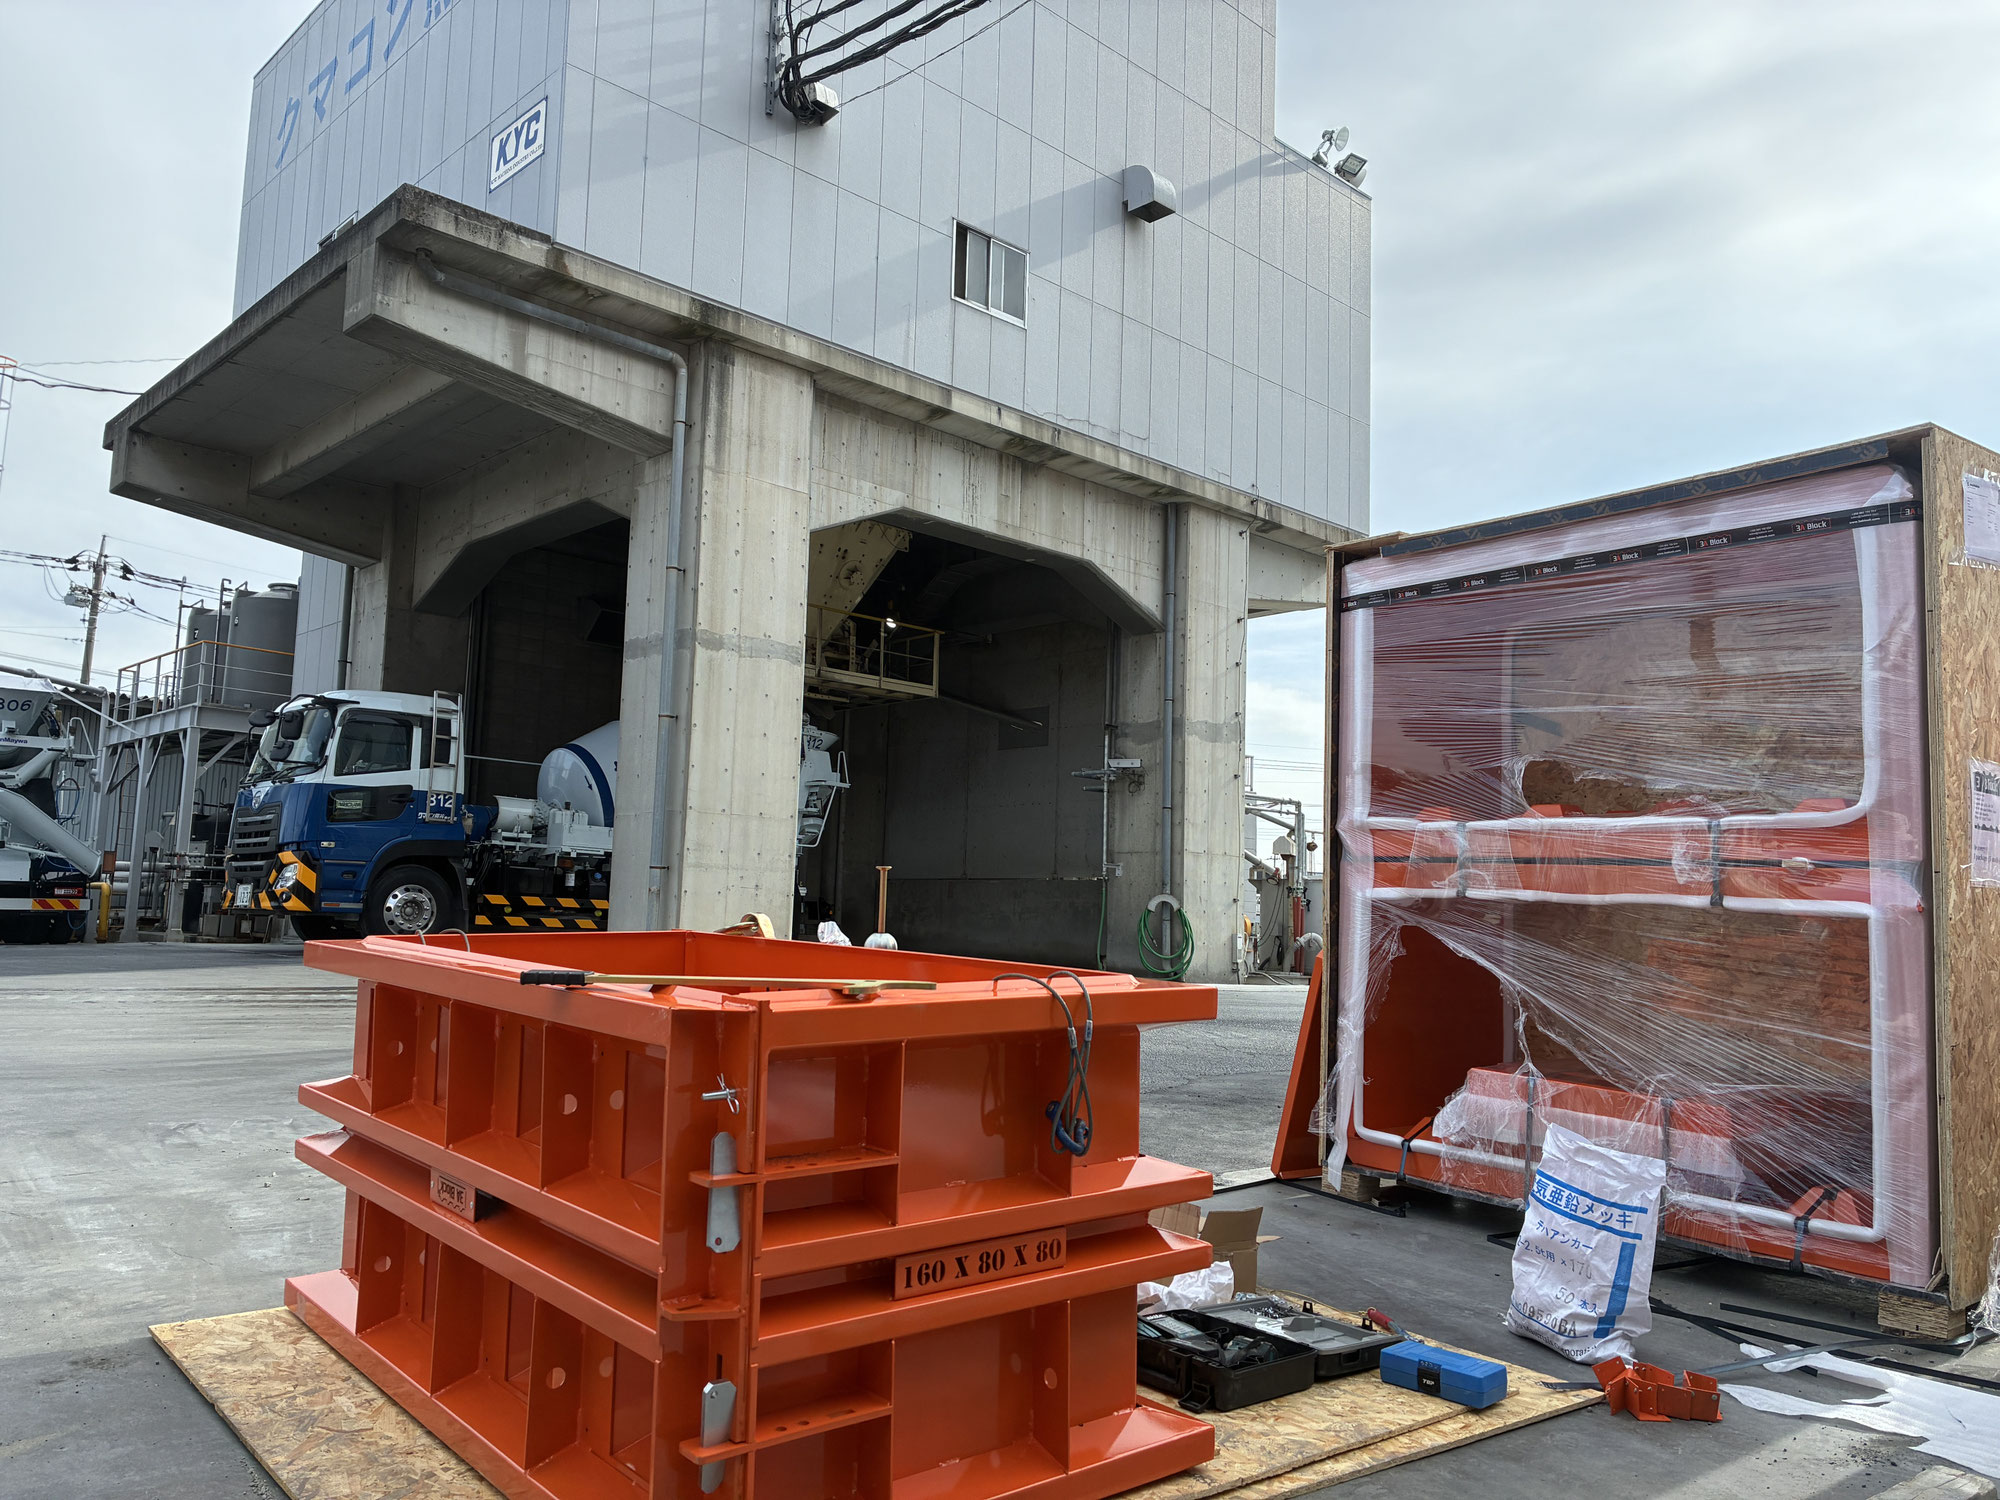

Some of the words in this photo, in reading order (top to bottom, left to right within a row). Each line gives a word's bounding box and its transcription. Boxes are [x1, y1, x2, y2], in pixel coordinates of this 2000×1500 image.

[496, 110, 541, 172] KYC
[1807, 521, 1827, 530] Block
[1699, 540, 1708, 548] 3A
[1709, 537, 1728, 546] Block
[1622, 552, 1639, 560] Block
[1542, 565, 1558, 574] Block
[441, 1181, 455, 1200] Block
[1532, 1176, 1633, 1229] 気亜鉛メッキ
[904, 1260, 946, 1289] 160
[955, 1255, 969, 1279] X
[978, 1249, 1005, 1274] 80
[1014, 1244, 1027, 1267] X
[1036, 1238, 1062, 1263] 80
